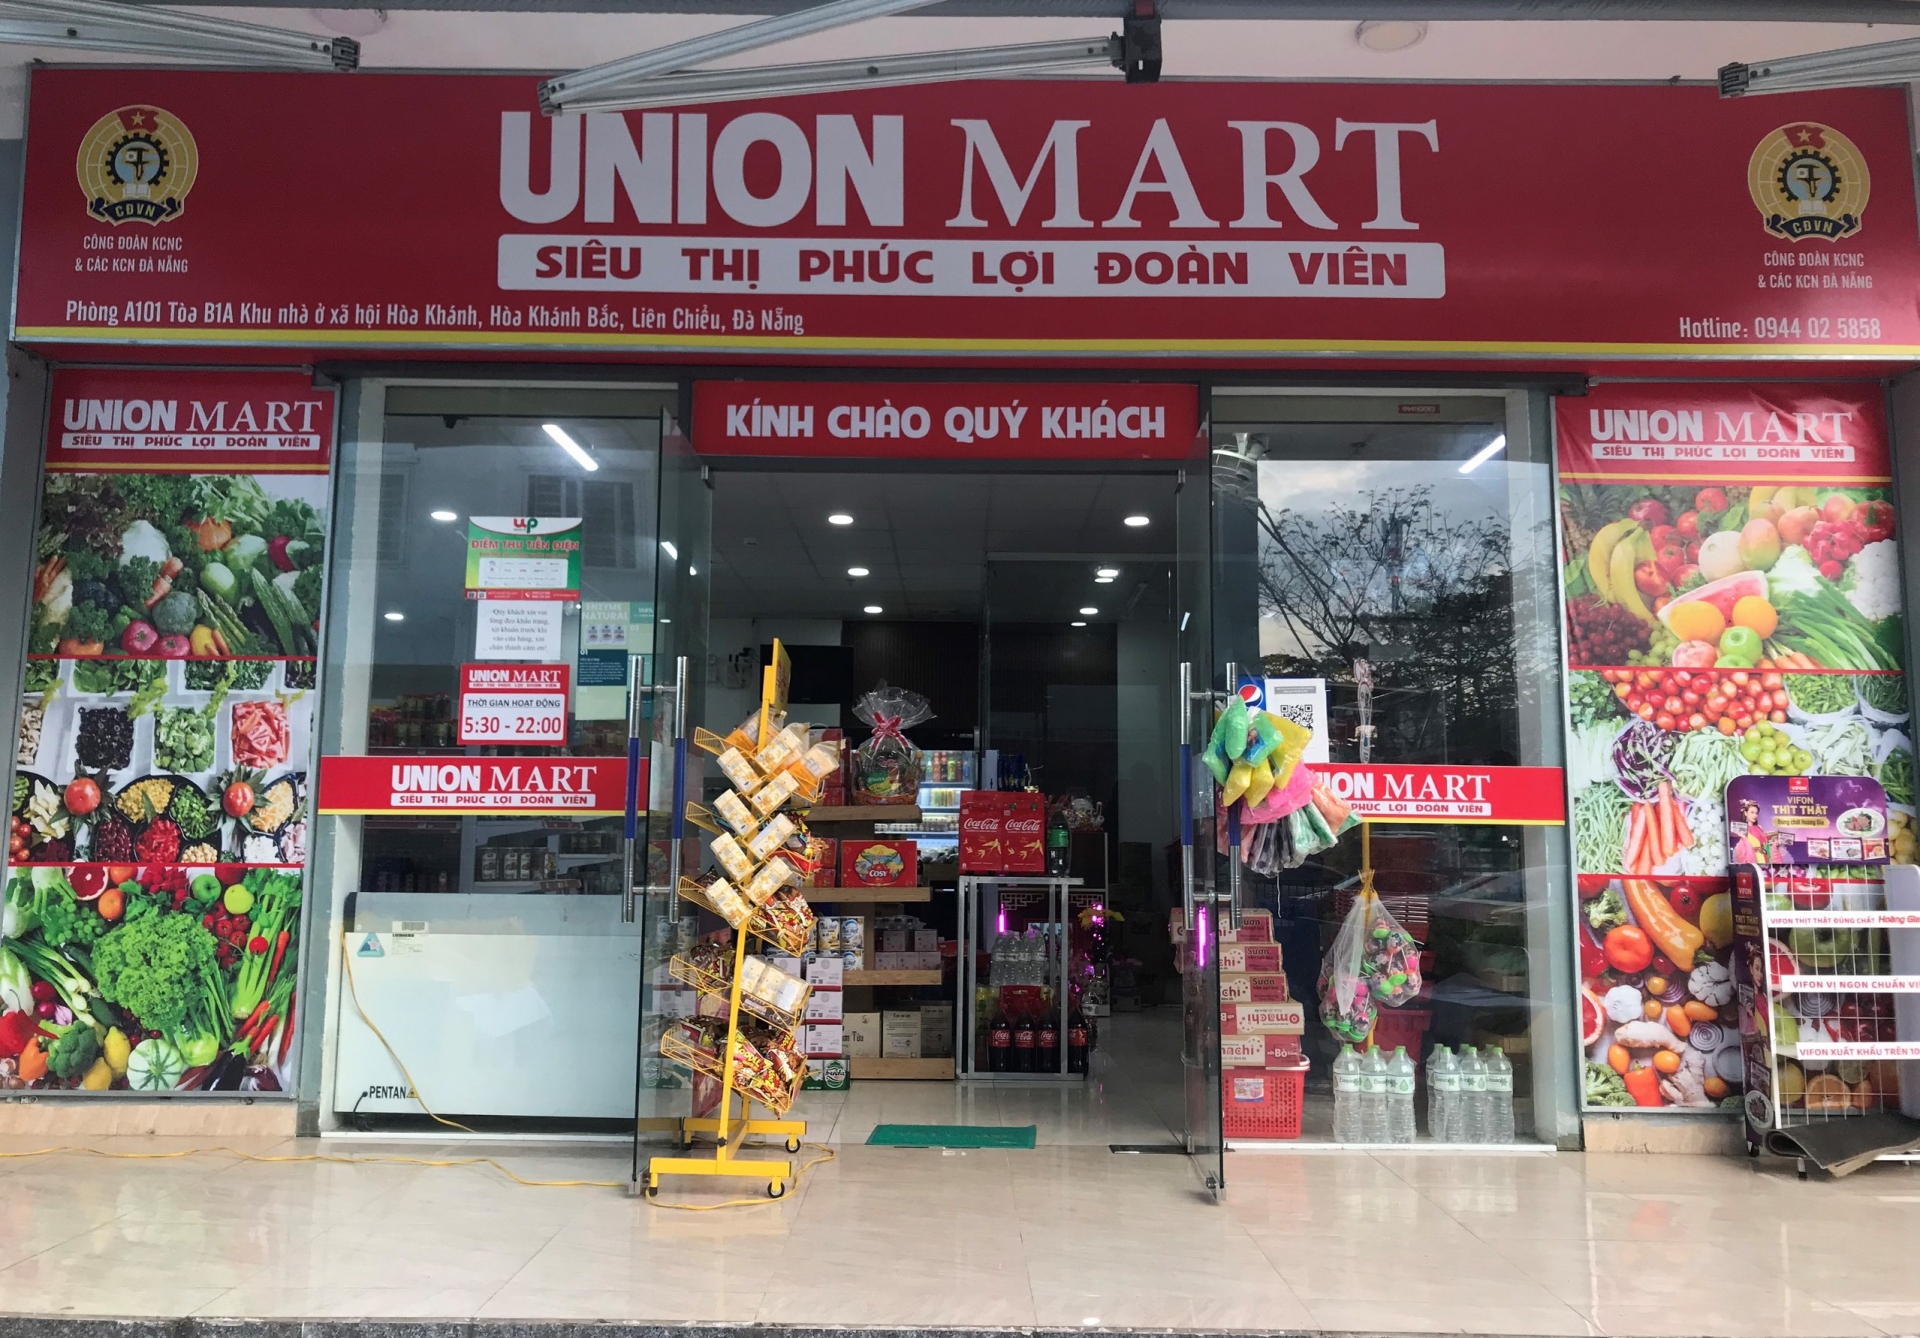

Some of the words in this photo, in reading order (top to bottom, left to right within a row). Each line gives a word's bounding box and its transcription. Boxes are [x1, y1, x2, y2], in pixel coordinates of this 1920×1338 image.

[500, 111, 904, 228] UNION
[945, 117, 1440, 230] MART
[114, 203, 156, 218] CĐVN
[1792, 219, 1834, 235] CĐVN
[83, 233, 114, 250] CÔNG
[118, 234, 149, 250] ĐOÀN
[152, 236, 183, 251] KCNC
[75, 258, 83, 272] &
[87, 256, 109, 272] CÁC
[112, 258, 136, 272] KCN
[139, 256, 154, 272] ĐÀ
[535, 239, 642, 280] SIÊU
[681, 248, 760, 290] THỊ
[798, 243, 934, 284] PHÚC
[972, 250, 1054, 293] LỢI
[1094, 245, 1249, 286] ĐOÀN
[1288, 245, 1408, 286] VIÊN
[1763, 250, 1795, 267] CÔNG
[1798, 249, 1830, 267] ĐOÀN
[1833, 253, 1864, 267] KCNC
[1758, 274, 1766, 288] &
[1769, 271, 1792, 289] CÁC
[1796, 275, 1818, 289] KCN
[1822, 272, 1839, 289] ĐÀ
[66, 300, 118, 326] Phòng
[124, 301, 161, 322] A101
[168, 302, 197, 323] Tòa
[204, 303, 233, 324] B1A
[240, 303, 271, 324] Khu
[278, 304, 308, 324] nhà
[315, 303, 326, 325] ở
[330, 304, 349, 325] xã
[355, 303, 380, 328] hội
[387, 305, 418, 326] Hòa
[425, 304, 483, 328] Khánh,
[490, 305, 522, 327] Hòa
[529, 306, 580, 327] Khánh
[587, 304, 625, 331] Bắc,
[632, 307, 666, 329] Liên
[673, 304, 726, 333] Chiểu,
[732, 309, 754, 331] Đà
[761, 307, 804, 335] Nẵng
[1679, 316, 1748, 339] Hotline:
[1755, 317, 1802, 339] 0944
[1808, 317, 1830, 339] 02
[1837, 317, 1881, 339] 5858
[63, 399, 177, 431] UNION
[186, 401, 322, 432] MART
[726, 398, 814, 438] KÍNH
[827, 399, 931, 439] CHÀO
[944, 400, 1028, 443] QUÝ
[1041, 400, 1165, 439] KHÁCH
[1590, 409, 1703, 442] UNION
[1714, 411, 1853, 443] MART
[72, 434, 102, 447] SIÊU
[113, 436, 135, 449] THỊ
[144, 434, 182, 447] PHÚC
[192, 436, 215, 449] LỢI
[226, 435, 268, 447] ĐOÀN
[278, 434, 310, 447] VIÊN
[1602, 443, 1632, 457] SIÊU
[1642, 446, 1665, 460] THỊ
[1675, 445, 1713, 458] PHÚC
[1723, 447, 1746, 460] LỢI
[1757, 445, 1800, 459] ĐOÀN
[1812, 445, 1844, 459] VIÊN
[471, 536, 499, 549] ĐIỂM
[502, 540, 523, 549] THU
[553, 539, 579, 552] ĐIỆN
[469, 670, 509, 682] UNION
[512, 670, 561, 682] MART
[489, 699, 510, 707] GIAN
[536, 698, 560, 708] ĐỘNG
[464, 716, 500, 733] 5:30
[515, 716, 562, 734] 22:00
[392, 765, 481, 791] UNION
[488, 765, 597, 792] MART
[1382, 773, 1490, 801] MART
[399, 794, 423, 803] SIÊU
[431, 796, 448, 806] THỊ
[456, 794, 486, 804] PHÚC
[493, 796, 512, 806] LỢI
[520, 794, 553, 804] ĐOÀN
[562, 794, 588, 804] VIÊN
[1351, 802, 1381, 811] PHÚC
[1416, 803, 1449, 812] ĐOÀN
[1457, 803, 1483, 813] VIÊN
[1787, 796, 1814, 804] VIFON
[1792, 980, 1823, 989] VIFON
[1826, 981, 1837, 991] VỊ
[1839, 980, 1869, 989] NGON
[1871, 978, 1906, 989] CHUẨN
[1248, 1013, 1300, 1025] Omachi
[1275, 1048, 1287, 1058] Bò
[1799, 1048, 1829, 1056] VIFON
[1830, 1046, 1854, 1056] XUẤT
[1885, 1046, 1908, 1056] TRÊN
[369, 1086, 406, 1099] PENTAN
